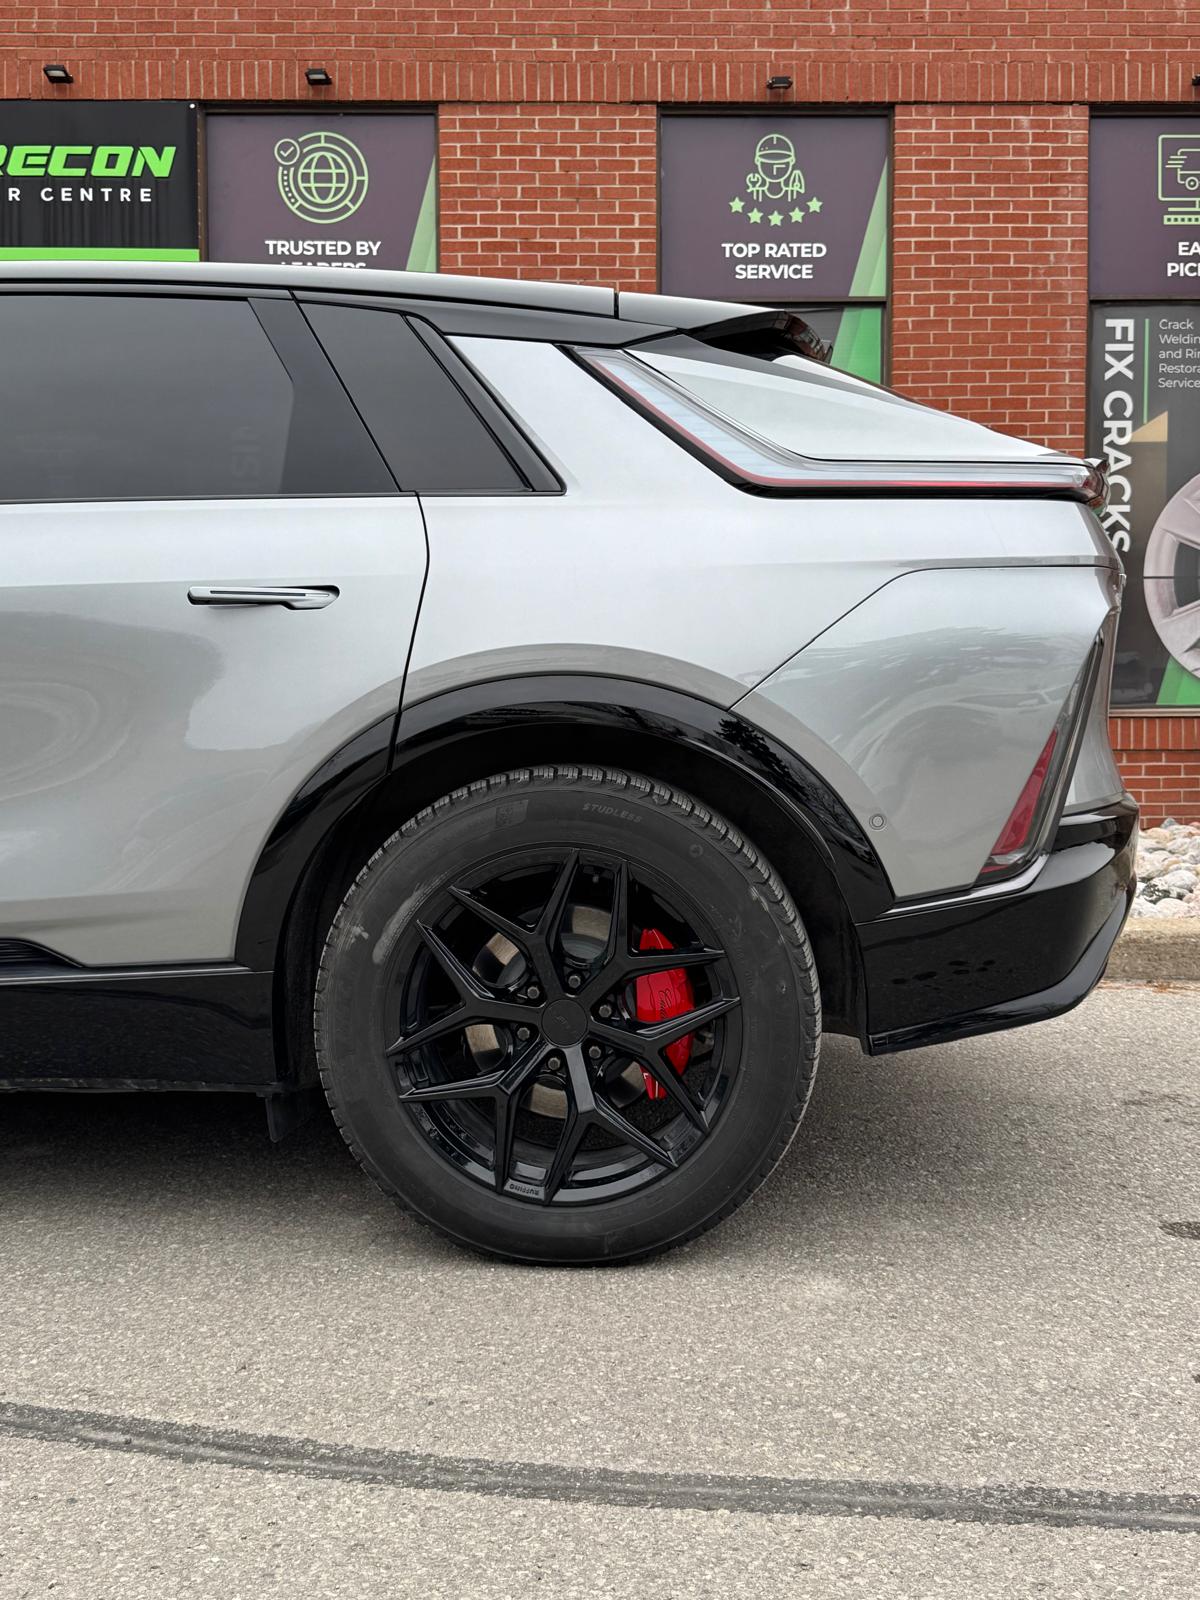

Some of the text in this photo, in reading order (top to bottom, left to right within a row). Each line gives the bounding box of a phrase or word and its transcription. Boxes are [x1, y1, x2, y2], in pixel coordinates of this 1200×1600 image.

[0, 145, 177, 177] ECON
[40, 187, 152, 202] CENTRE
[264, 240, 381, 256] TRUSTED BY
[721, 243, 827, 258] TOP RATED
[735, 264, 813, 279] SERVICE
[1167, 262, 1200, 277] PIC
[1158, 318, 1194, 330] Crack
[1104, 318, 1135, 381] FIX
[1158, 348, 1200, 359] and Ri
[582, 802, 642, 823] STUDLESS
